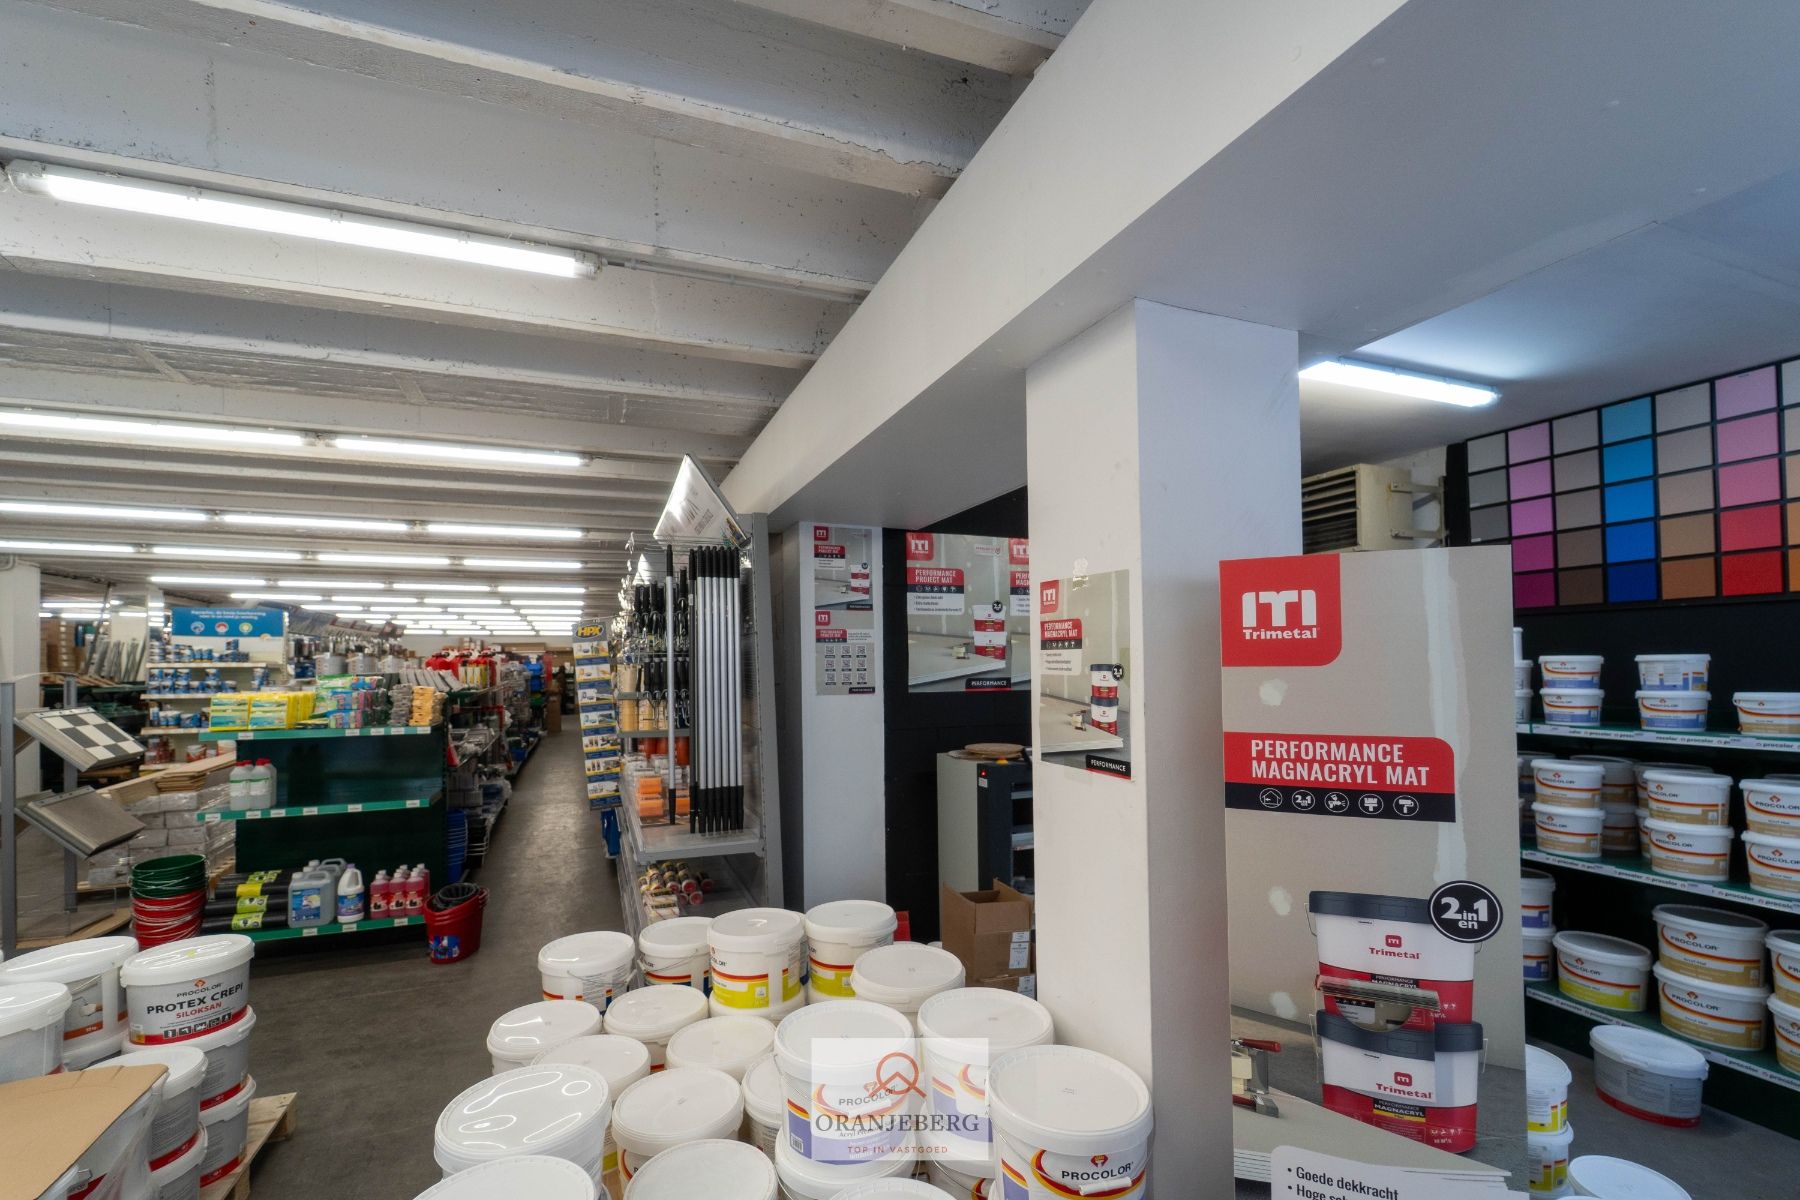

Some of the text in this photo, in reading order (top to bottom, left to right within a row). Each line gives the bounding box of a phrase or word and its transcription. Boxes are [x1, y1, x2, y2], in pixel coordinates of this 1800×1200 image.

[915, 569, 956, 577] PERFORMANCE
[915, 576, 940, 584] PROJECT
[577, 625, 601, 637] HPX
[1242, 627, 1318, 640] Trimetal
[1251, 740, 1404, 763] PERFORMANCE
[1090, 759, 1126, 772] PERFORMANCE
[1252, 761, 1430, 786] MAGNACRYL MAT
[1655, 838, 1693, 848] PROCOLOR
[1670, 934, 1719, 951] PROCOLOR
[1369, 947, 1421, 960] Trimetal
[147, 982, 244, 1014] PROTEX CREPI
[176, 983, 222, 998] PROCOLOR
[176, 1001, 222, 1019] SILOKSAN
[1671, 993, 1720, 1012] PROCOLOR
[838, 1084, 896, 1107] PROCOLOR
[1375, 1082, 1433, 1099] Trimetal
[1374, 1104, 1425, 1117] MAGNACRYL
[1061, 1162, 1132, 1181] PROCOLOR
[1296, 1166, 1400, 1200] Goede dekkracht
[1296, 1184, 1327, 1200] Hoge
